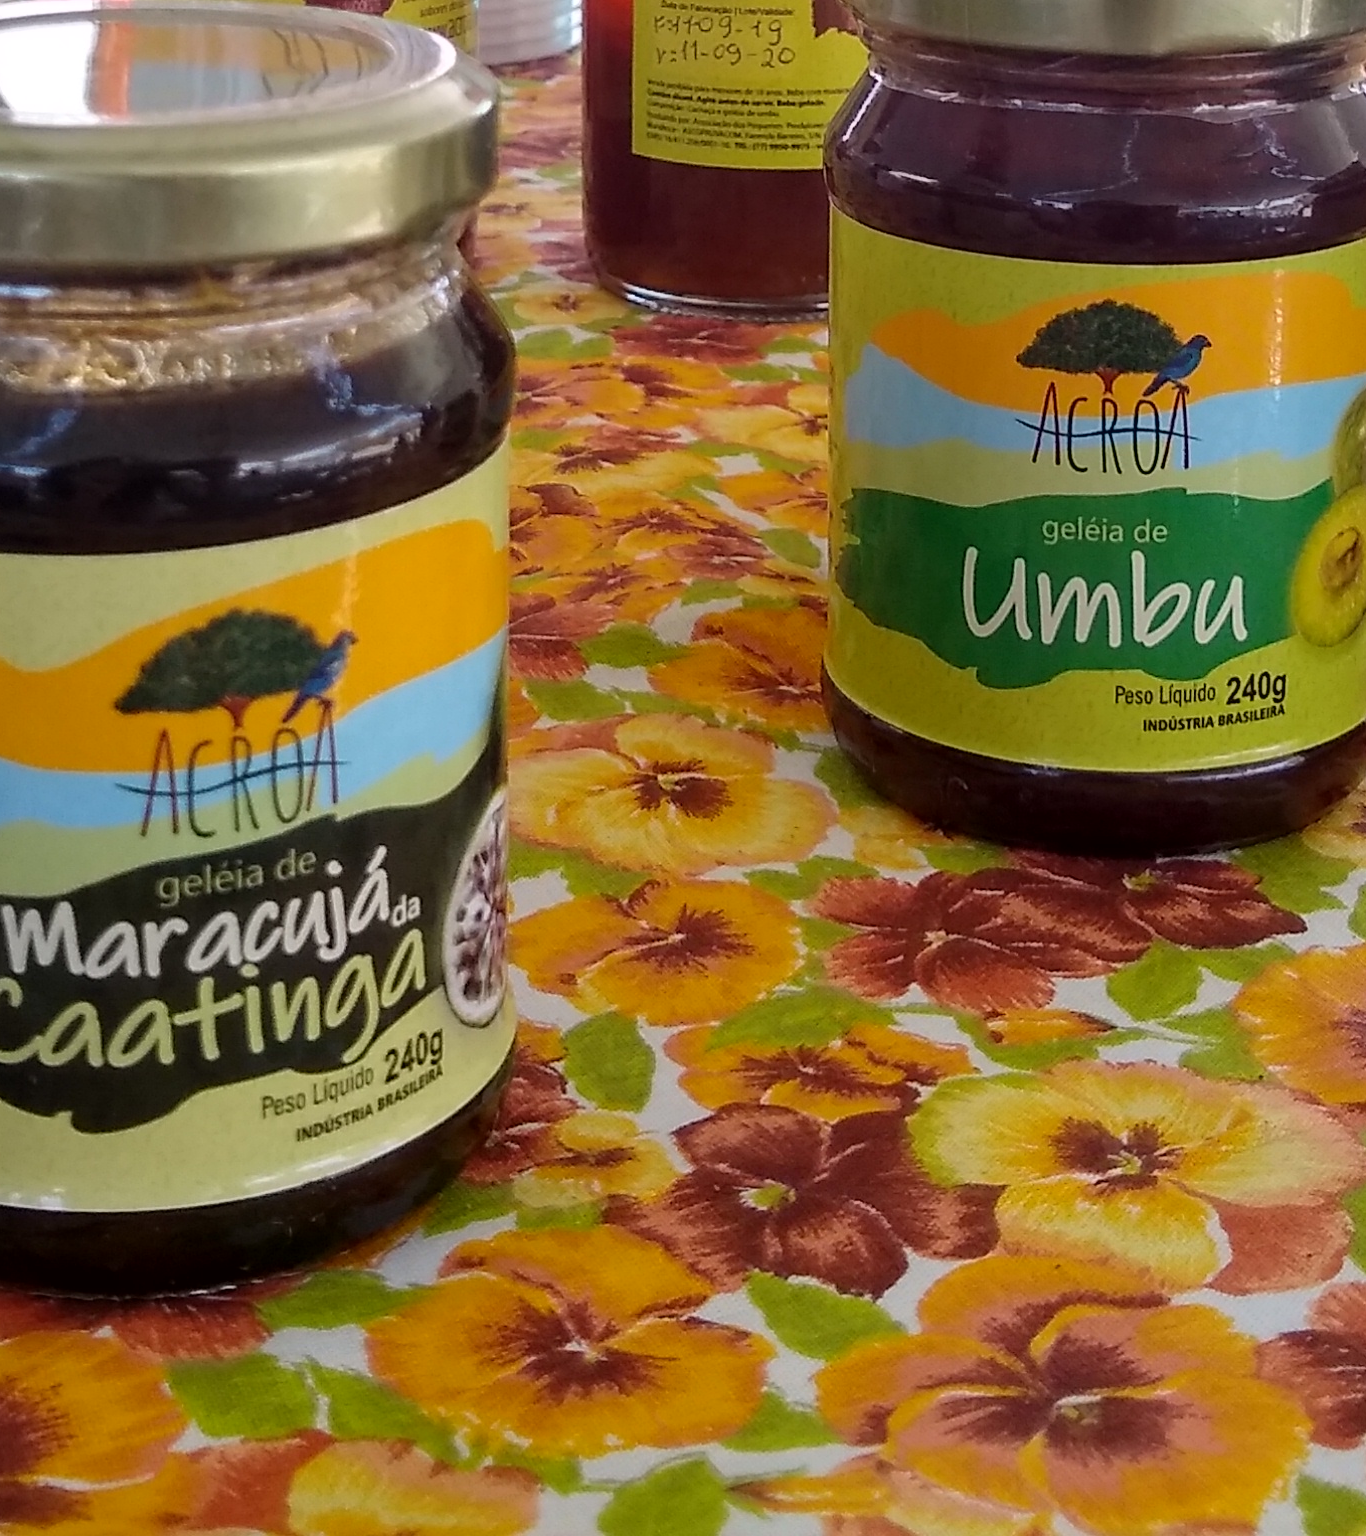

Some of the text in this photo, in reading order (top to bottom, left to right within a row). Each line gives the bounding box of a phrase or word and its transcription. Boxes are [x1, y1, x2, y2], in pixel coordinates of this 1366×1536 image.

[1041, 515, 1169, 546] geléia de
[961, 545, 1249, 648] Umbu
[1114, 670, 1287, 708] Peso Líquido 240g
[1142, 703, 1286, 732] INDÚSTRIA BRASILEIRA
[155, 846, 318, 909] geléia de
[390, 894, 422, 929] da
[261, 1028, 444, 1120] Peso Líquido 240g
[295, 1064, 444, 1143] INDÚSTRIA BRASILEIRA
